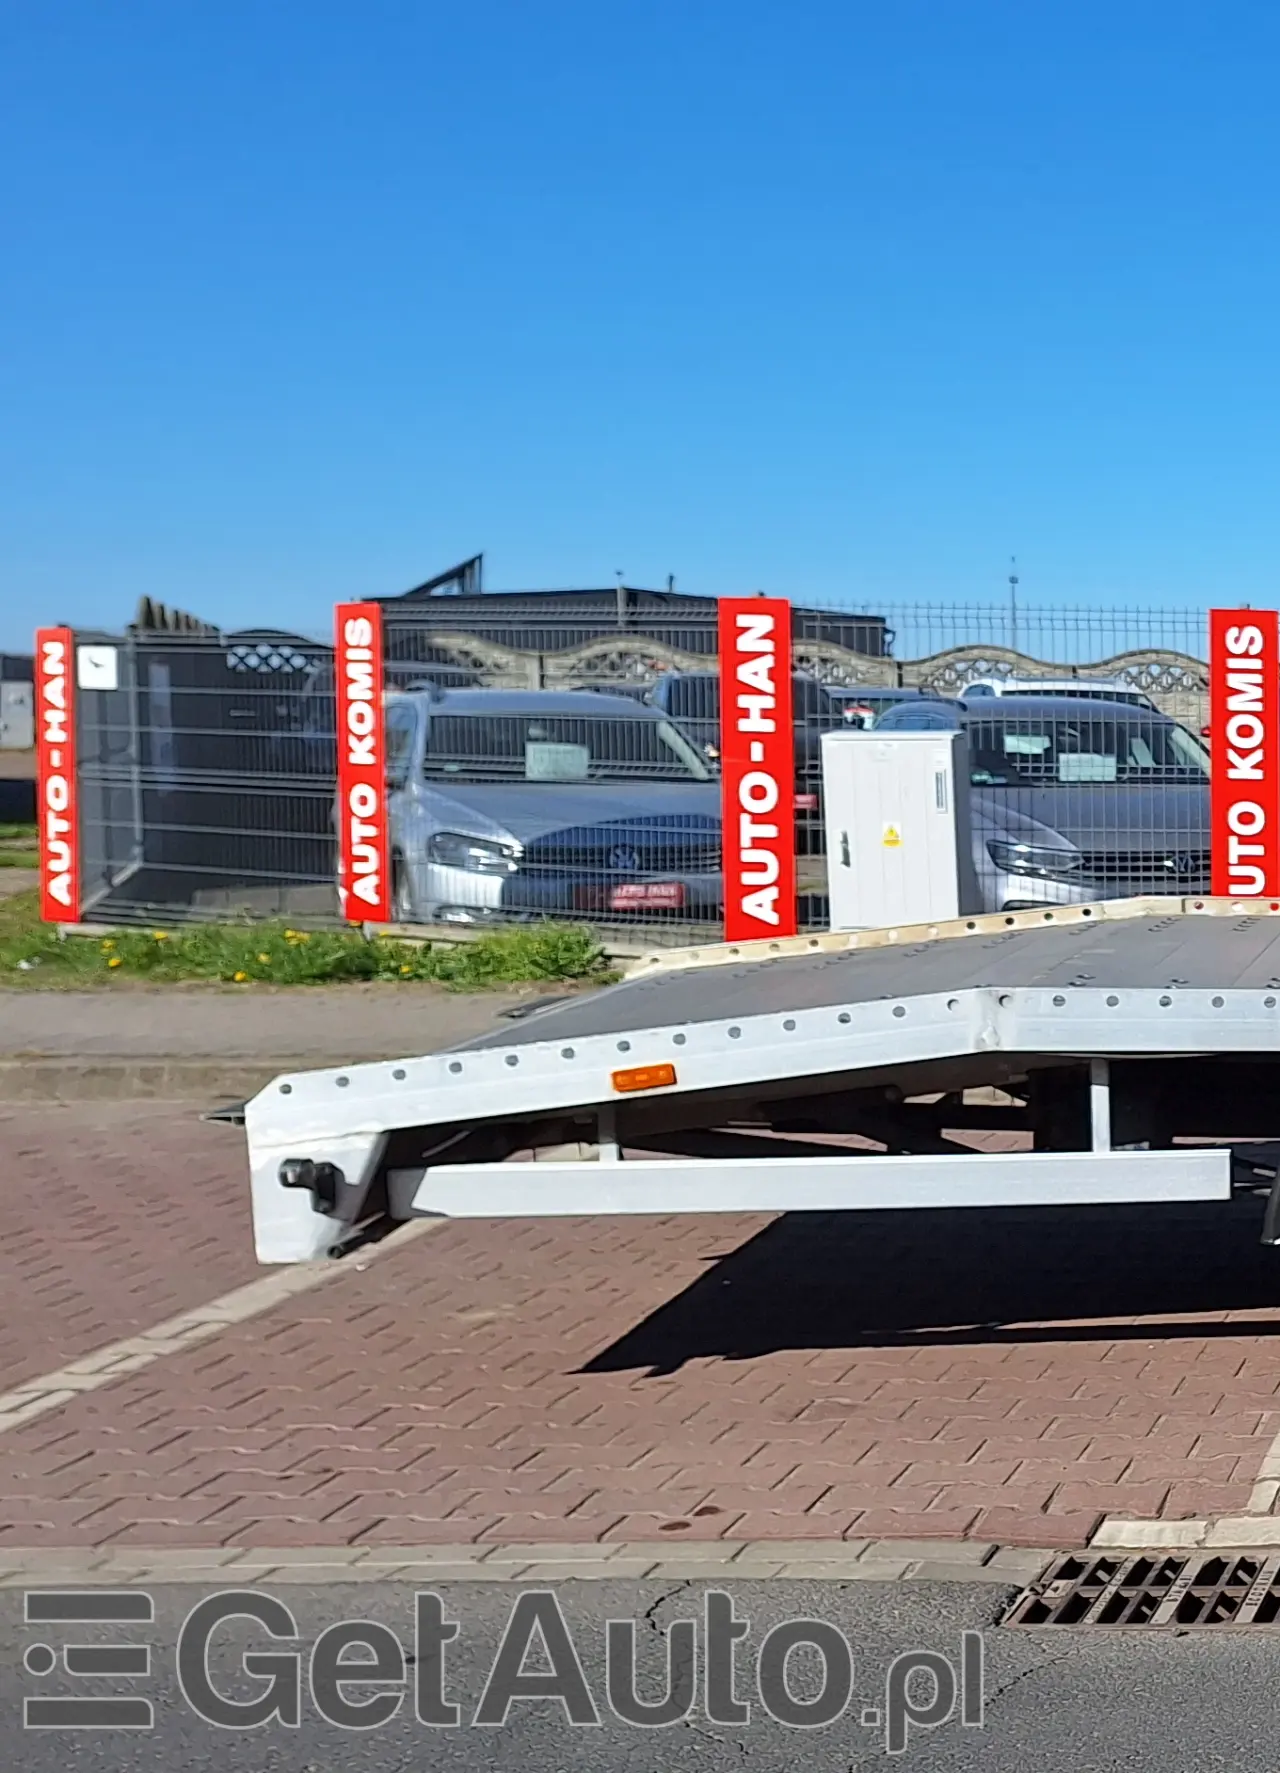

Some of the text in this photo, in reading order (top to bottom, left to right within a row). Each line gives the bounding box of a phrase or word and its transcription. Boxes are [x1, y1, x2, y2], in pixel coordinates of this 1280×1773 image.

[42, 641, 73, 906] AUTO-HAN
[344, 617, 380, 905] AUTO KOMIS
[735, 614, 780, 925] AUTO-HAN
[1225, 625, 1266, 896] UTO KOMIS
